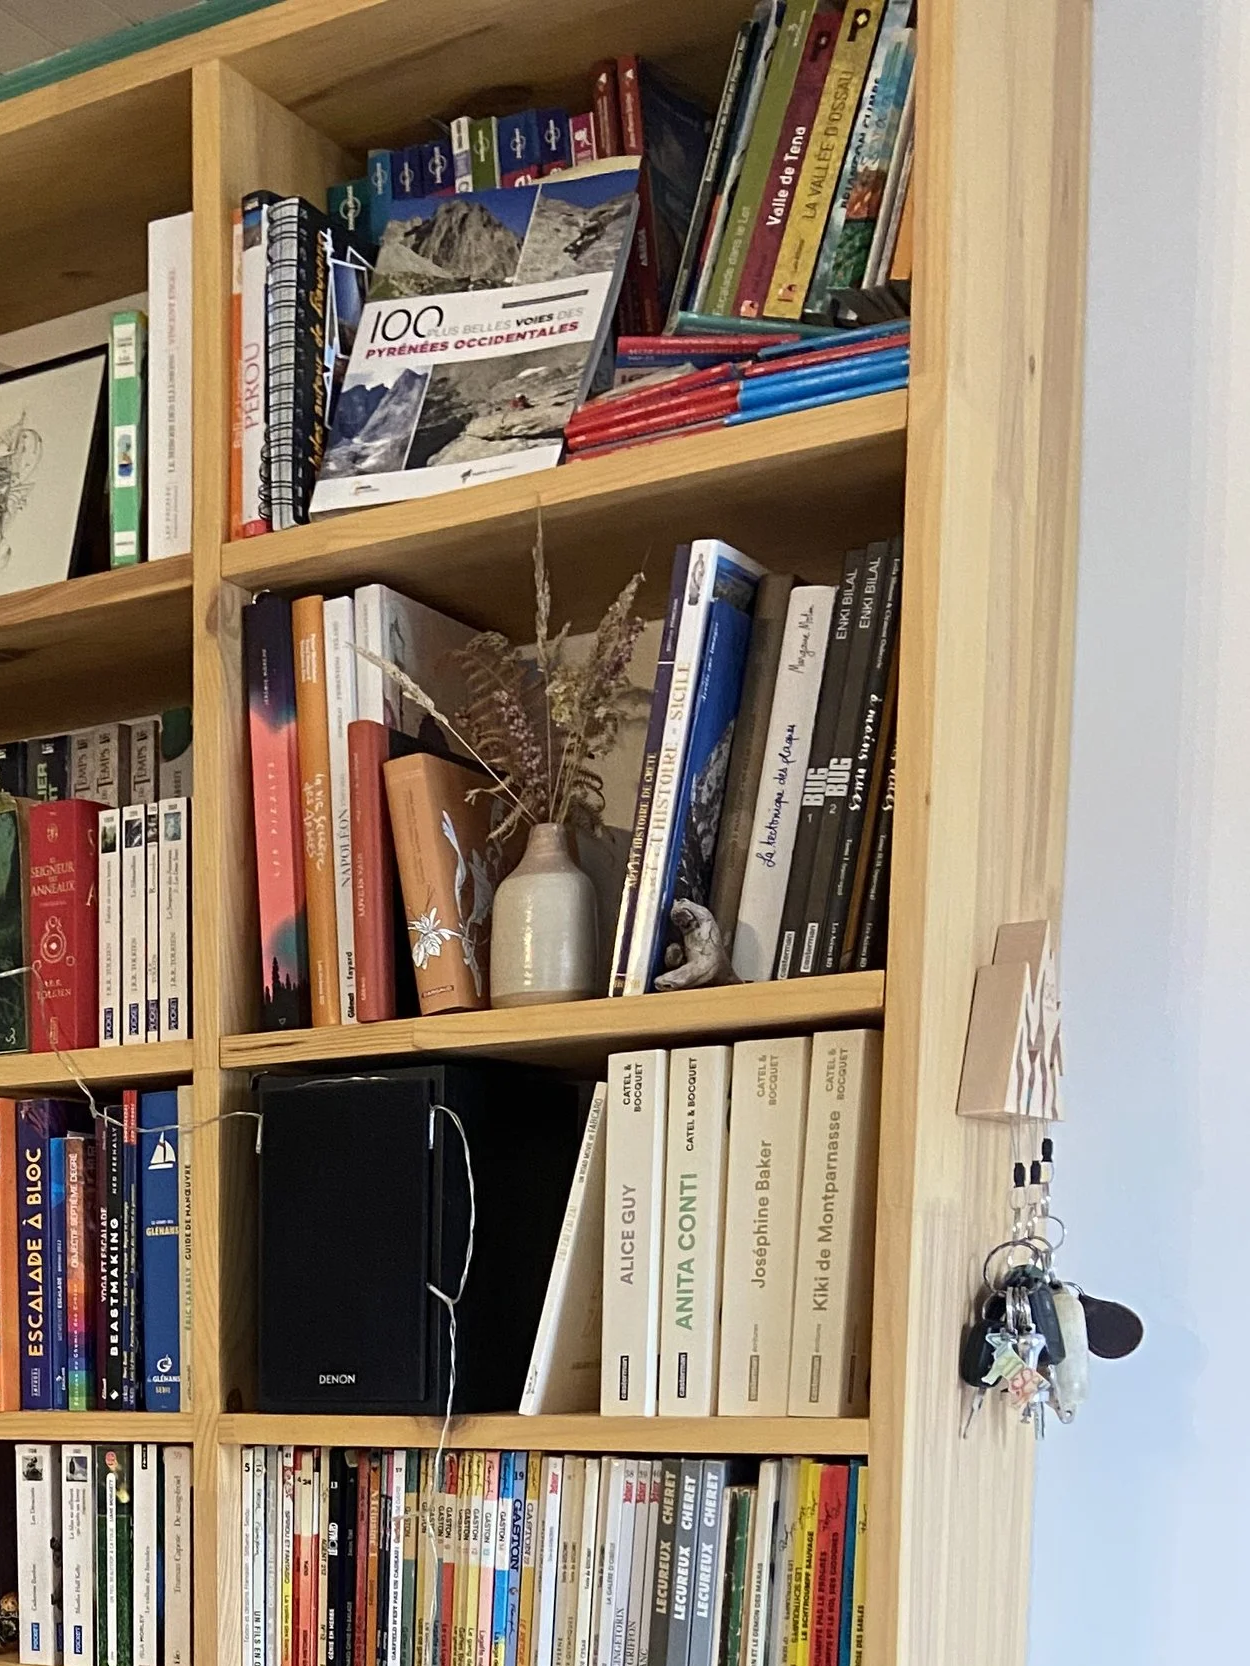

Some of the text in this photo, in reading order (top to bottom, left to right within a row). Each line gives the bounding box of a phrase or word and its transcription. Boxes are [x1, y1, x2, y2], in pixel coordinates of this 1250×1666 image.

[802, 70, 854, 220] LA VALLÉE D'OSSAU
[766, 126, 807, 226] Valle de Tena
[365, 321, 579, 359] PYRÉNÉES OCCIDENTALES
[370, 305, 444, 343] 100
[427, 306, 584, 338] PLUS BELLES VOIES DES
[836, 567, 858, 642] ENKI BILAL
[858, 556, 881, 629] ENKI BILAL
[773, 767, 788, 786] des
[802, 766, 830, 807] BUG
[825, 757, 852, 798] BUG
[30, 861, 75, 878] SEIGNEUR
[30, 880, 76, 898] ANNEAUX
[622, 1063, 632, 1106] CATEL &
[633, 1063, 643, 1113] BOCQUET
[756, 1064, 767, 1098] CATEL
[768, 1054, 780, 1106] BOCQUET
[825, 1058, 836, 1092] CATEL
[837, 1048, 848, 1101] BOCQUET
[686, 1057, 698, 1152] CATEL BOCQUET
[751, 1139, 772, 1289] Joséphine Baker
[812, 1110, 841, 1312] Kiki de Montparnasse
[21, 1148, 43, 1357] ESCALADE À BLOC
[70, 1228, 80, 1269] OBJECTIF
[620, 1184, 636, 1285] ALICE GUY
[675, 1173, 698, 1331] ANITA CONTI
[109, 1218, 119, 1356] BEASTMAKING
[318, 1374, 356, 1385] DENON
[620, 1357, 629, 1400] casterman
[678, 1353, 687, 1397] casterman
[437, 1505, 445, 1537] GASTON
[444, 1506, 452, 1539] GASTON
[463, 1508, 471, 1541] GASTON
[472, 1508, 480, 1541] GASTON
[483, 1512, 492, 1543] GASTON
[498, 1511, 507, 1542] GASTON
[510, 1499, 523, 1573] GASTON
[524, 1502, 534, 1557] GASTON
[655, 1470, 676, 1614] LECUREUX CHERET
[674, 1475, 696, 1621] LECUREUX CHERET
[696, 1471, 719, 1618] LECUREUX CHERET
[283, 1549, 291, 1583] FANTASIO
[755, 1562, 763, 1593] MARAIS
[253, 1610, 262, 1624] UN
[802, 1571, 811, 1629] SCHTROUMPF
[856, 1604, 864, 1633] SABLES
[253, 1625, 262, 1645] FILS
[253, 1647, 262, 1659] EN
[477, 1630, 487, 1656] Lagaffe
[625, 1620, 637, 1665] GRIFFON
